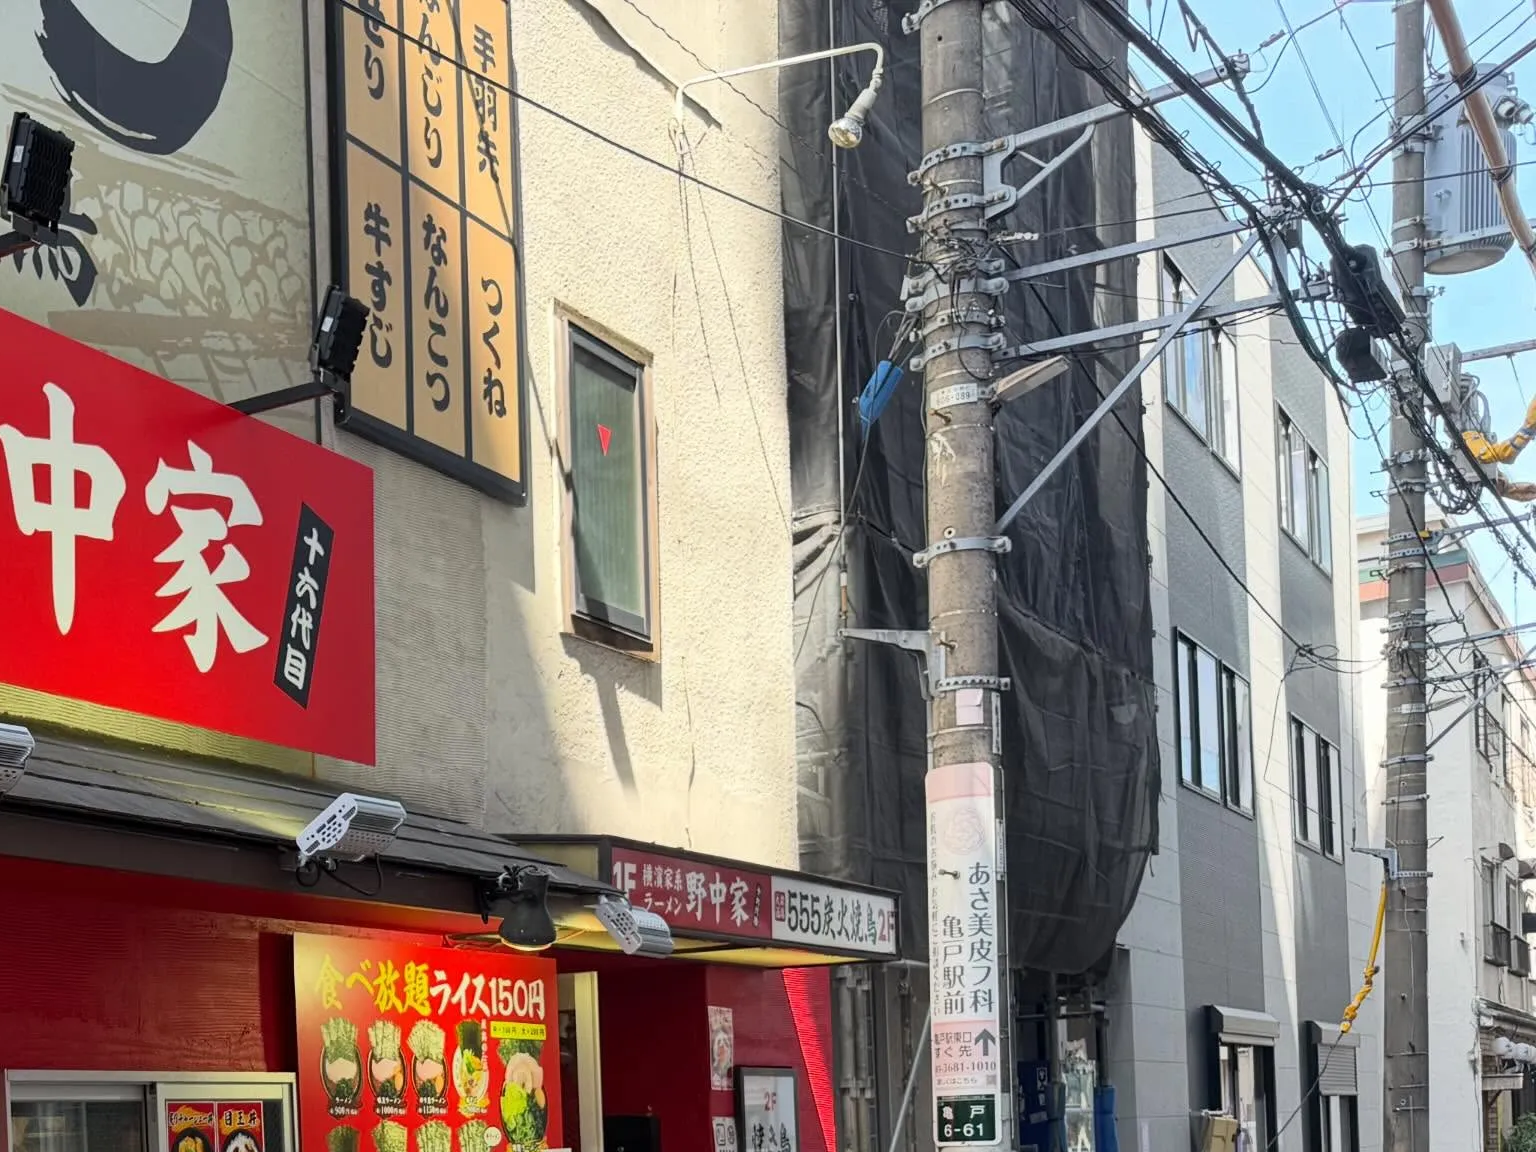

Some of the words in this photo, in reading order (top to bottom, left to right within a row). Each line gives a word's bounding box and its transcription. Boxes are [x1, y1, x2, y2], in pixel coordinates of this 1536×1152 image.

[470, 24, 500, 183] 手羽先
[364, 202, 393, 369] 牛すじ
[421, 213, 451, 413] なんこつ
[481, 276, 507, 418] つくね
[283, 527, 326, 691] 十六代目
[644, 892, 682, 916] ラーメン
[685, 871, 749, 927] 野中家
[942, 915, 965, 1015] 亀戸駅前
[968, 861, 995, 1014] あさ美皮フ科
[935, 1046, 972, 1058] すぐ先
[944, 1123, 984, 1137] 6-61
